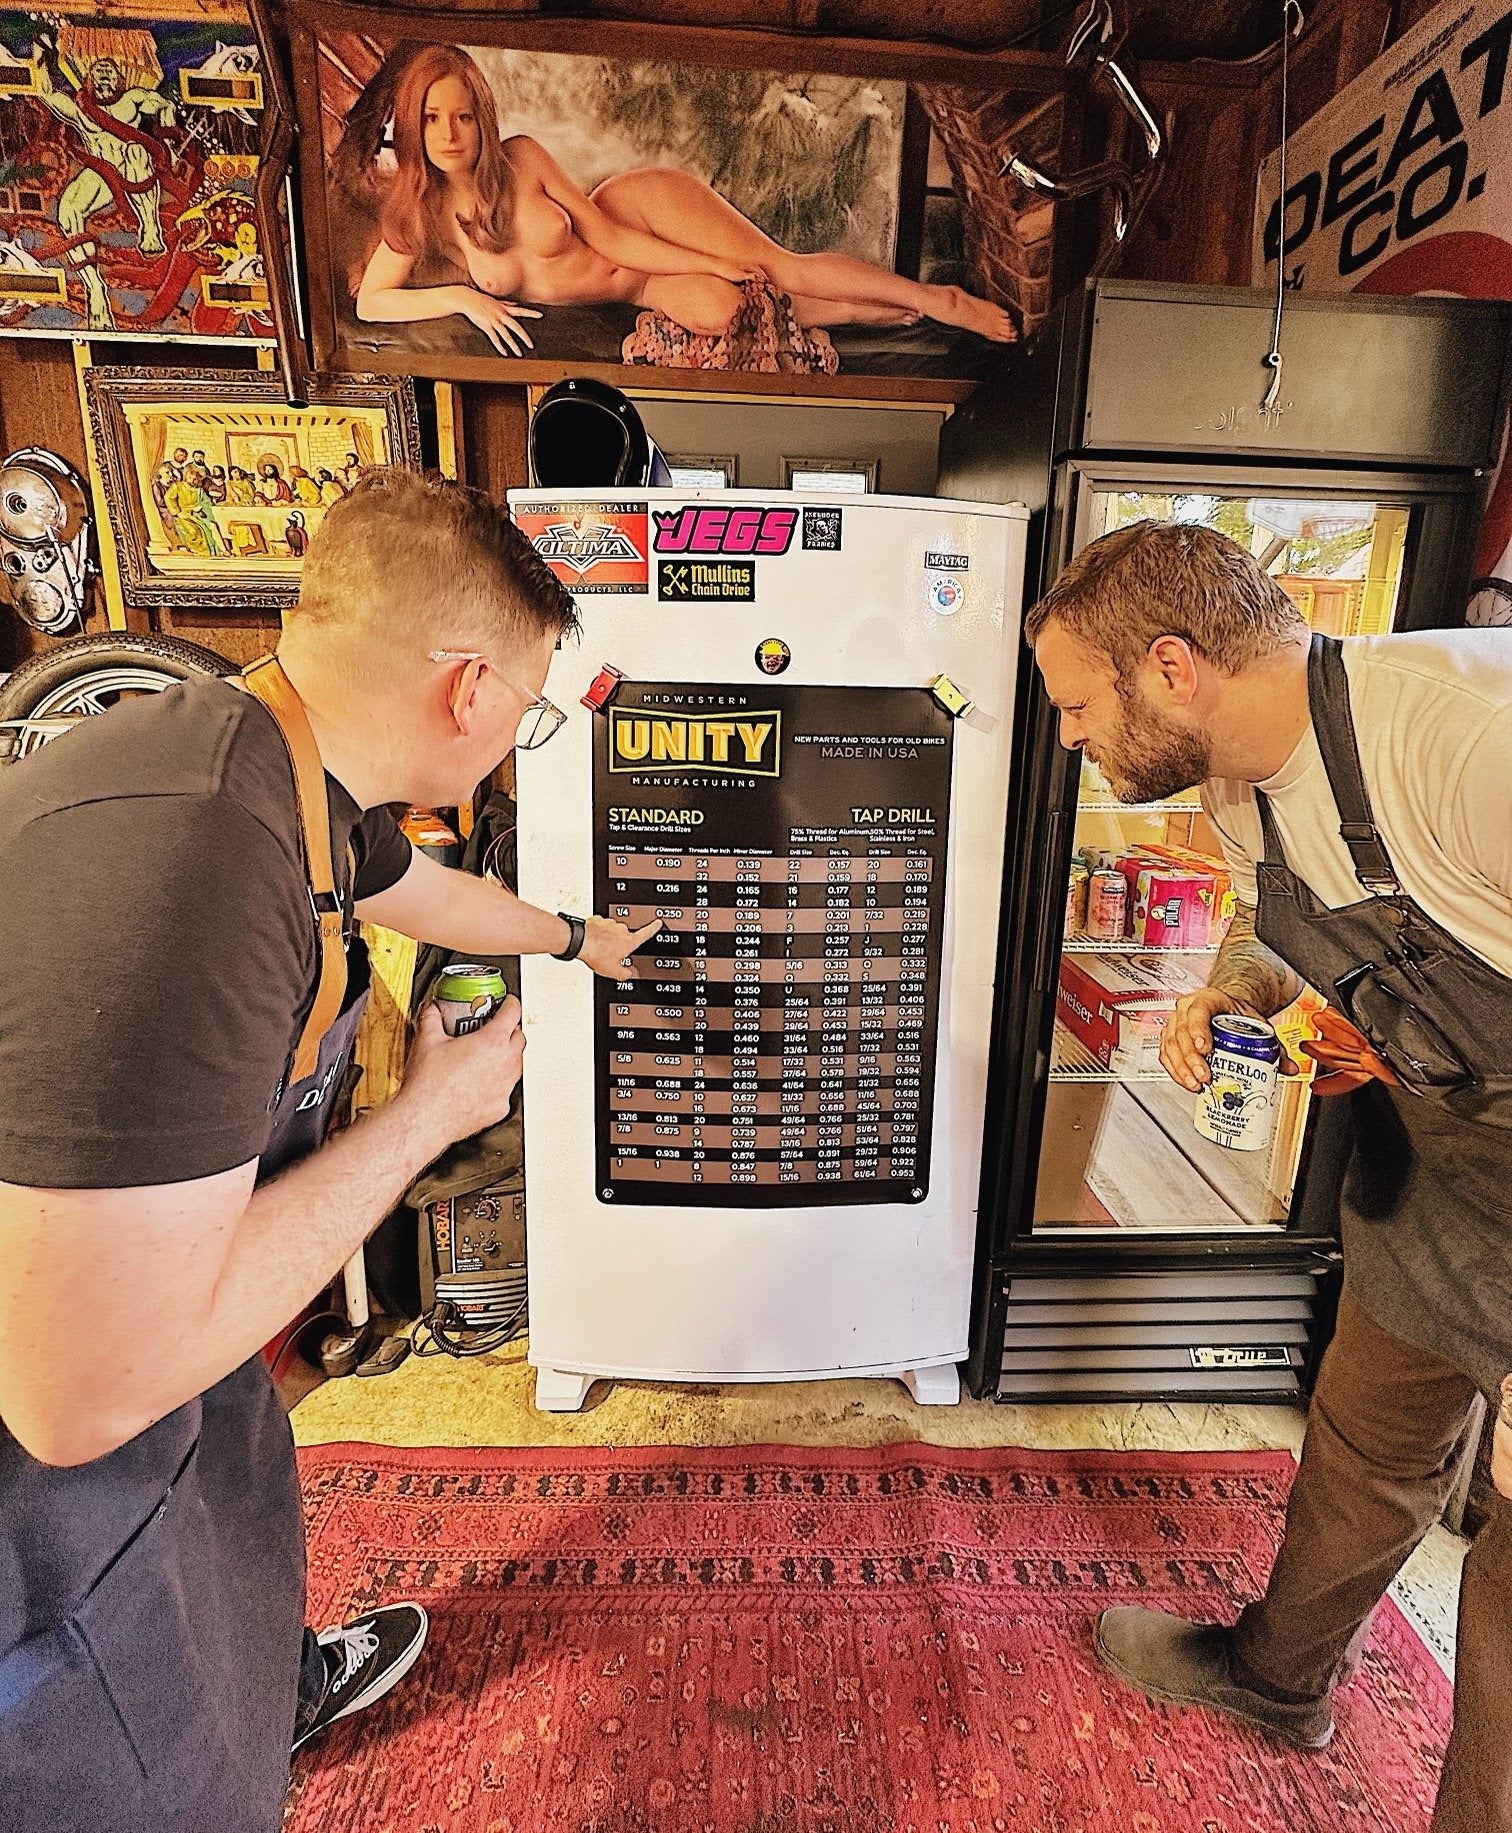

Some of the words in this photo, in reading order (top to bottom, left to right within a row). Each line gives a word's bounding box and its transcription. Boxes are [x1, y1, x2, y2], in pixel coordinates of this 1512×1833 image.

[1338, 141, 1488, 277] CO.
[657, 510, 795, 551] JEGS
[541, 542, 624, 555] ULTIMA
[929, 555, 968, 566] MAYTAG
[691, 565, 750, 583] Mullins
[691, 584, 720, 595] Chain
[722, 584, 750, 595] Drive
[933, 580, 961, 593] AMRICA
[644, 696, 746, 704] MIDWESTERN
[617, 720, 772, 762] UNITY
[822, 747, 864, 758] MADE
[869, 748, 882, 758] IN
[888, 748, 918, 758] USA
[633, 778, 754, 787] MANUFACTURING
[609, 808, 704, 825] STANDARD
[852, 809, 883, 823] TAP
[889, 809, 935, 823] DRILL
[657, 858, 680, 866] 0.190
[738, 860, 761, 868] 0.139
[789, 860, 800, 869] 22
[828, 860, 851, 869] 0.157
[868, 861, 880, 869] 20
[657, 909, 681, 917] 0.250
[737, 911, 759, 919] 0.189
[826, 911, 850, 919] 0.201
[865, 911, 883, 919] 7/32
[1166, 901, 1181, 926] POLAR
[1060, 986, 1093, 1025] weiser
[733, 1093, 756, 1101] 0.627
[1206, 1105, 1249, 1122] BLACKBERRY
[1208, 1113, 1246, 1129] LEMONADE
[437, 1200, 450, 1251] HOBAR
